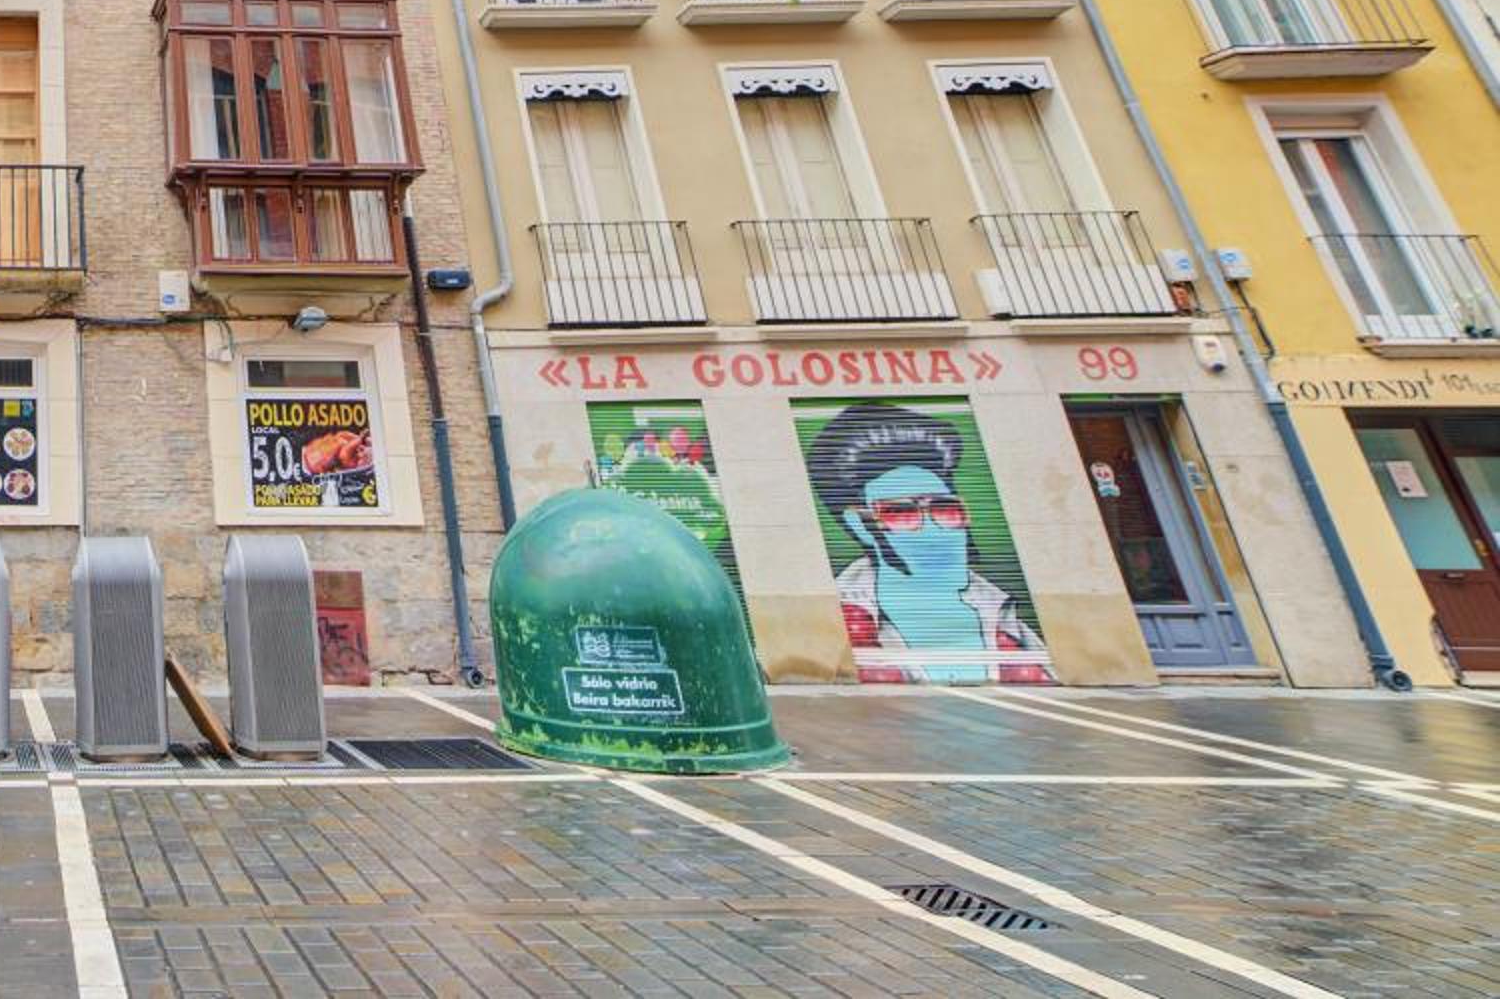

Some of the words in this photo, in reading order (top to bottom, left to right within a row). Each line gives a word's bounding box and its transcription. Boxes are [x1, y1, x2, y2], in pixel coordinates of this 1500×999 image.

[1079, 347, 1138, 380] 99
[251, 403, 304, 426] POLLO
[308, 403, 366, 426] ASADO
[616, 676, 659, 691] vidrio
[573, 692, 609, 706] Beira
[612, 693, 677, 708] bakarrik
